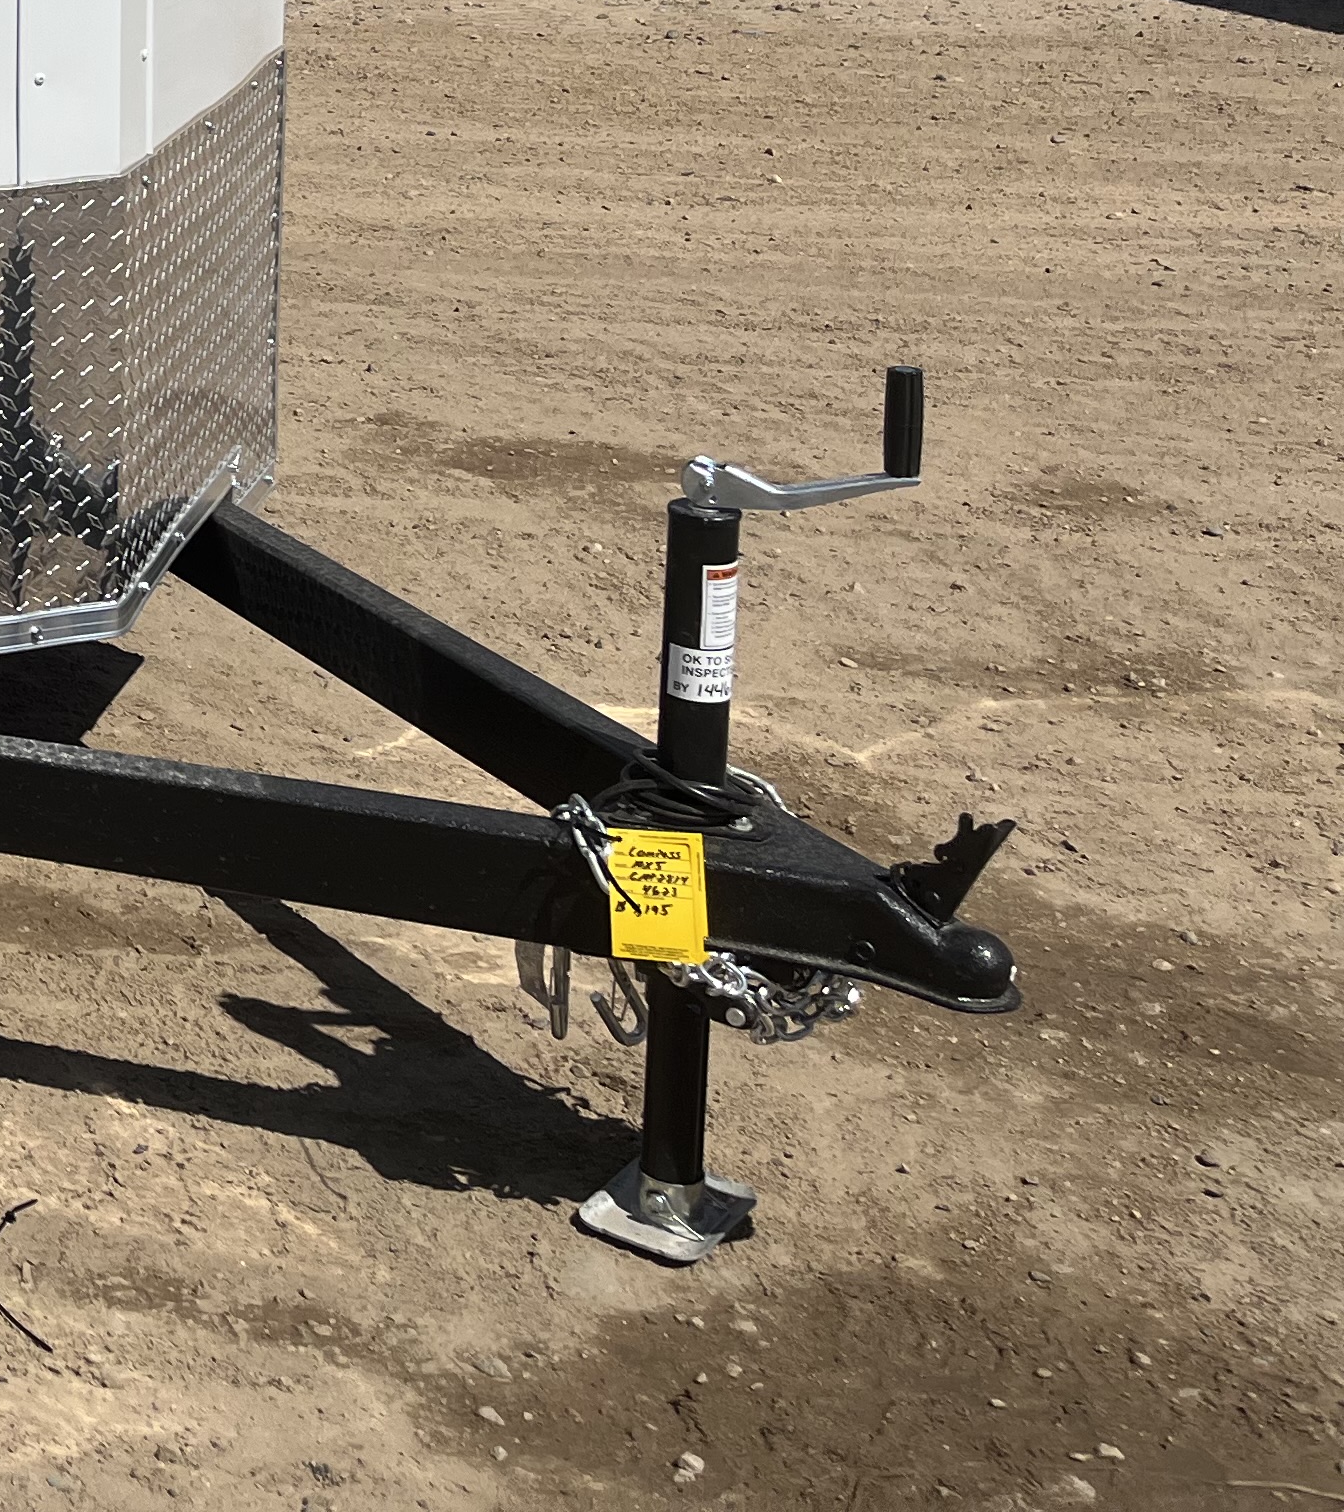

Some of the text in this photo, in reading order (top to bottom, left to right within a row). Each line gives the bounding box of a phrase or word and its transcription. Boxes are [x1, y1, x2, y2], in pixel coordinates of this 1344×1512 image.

[682, 653, 702, 665] OK
[706, 656, 722, 666] TO
[673, 680, 689, 693] BY
